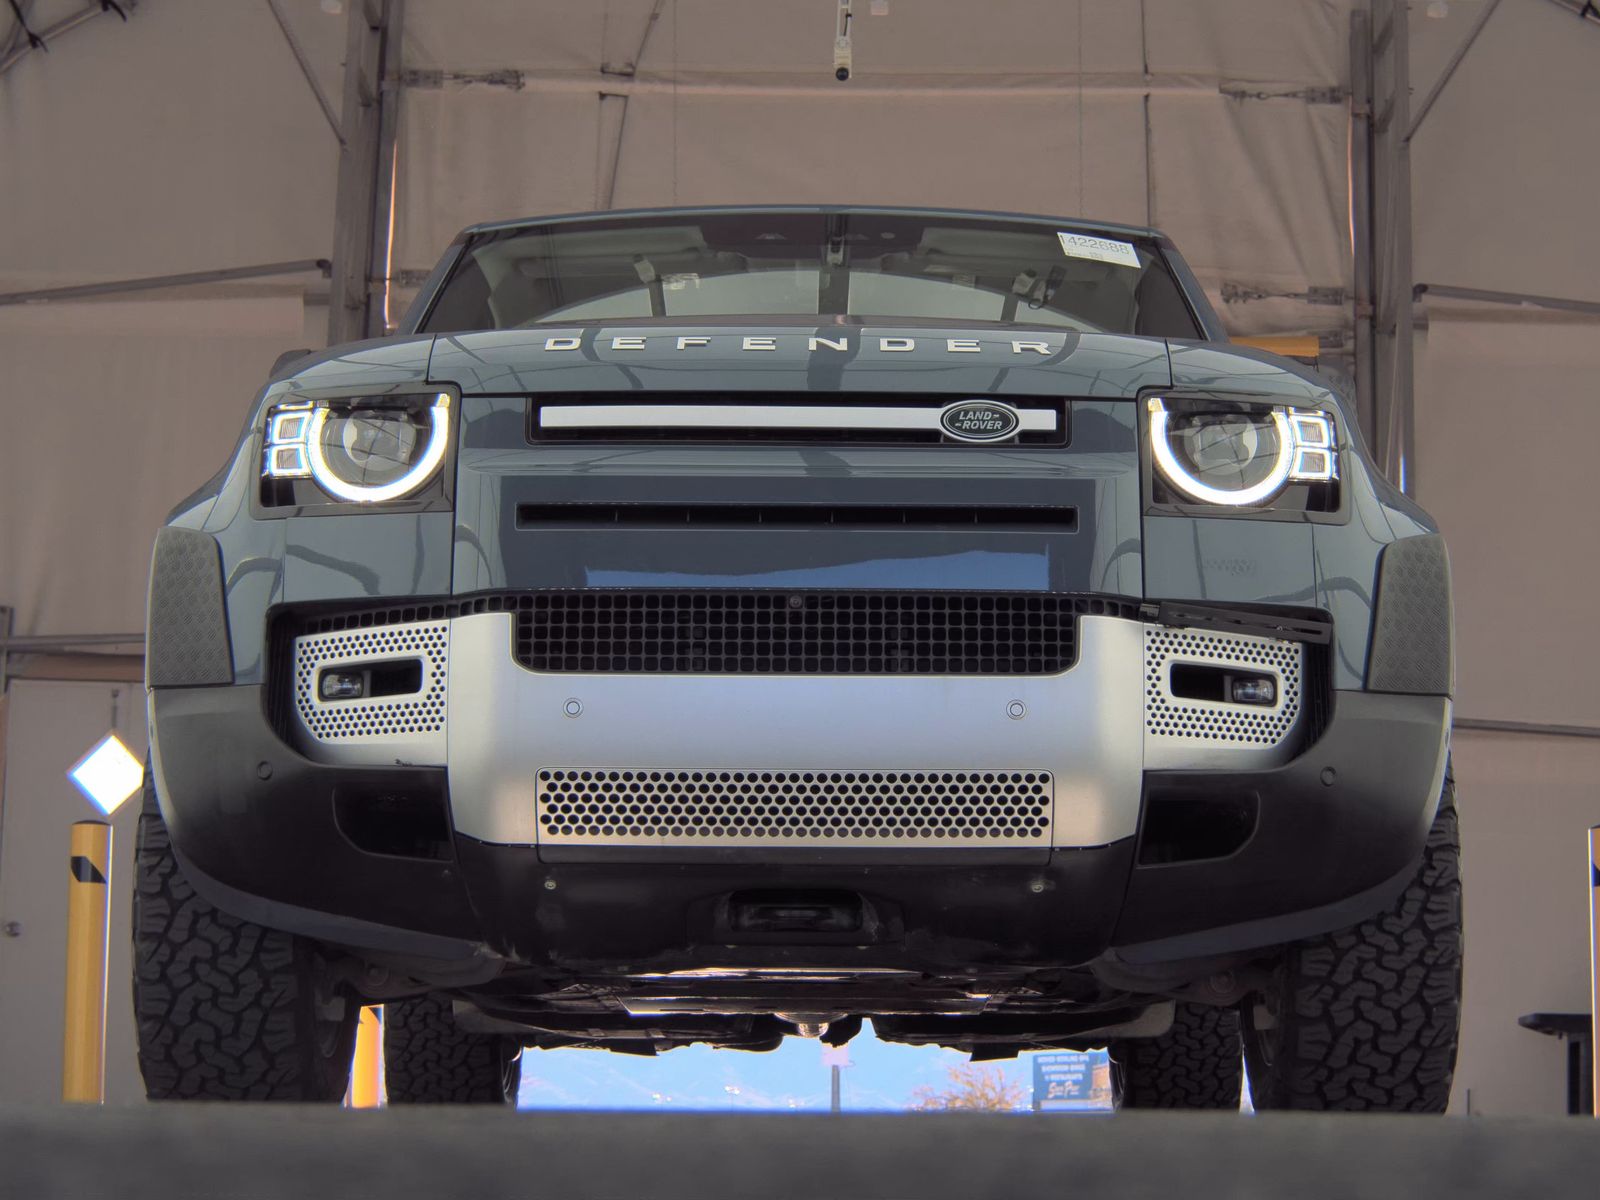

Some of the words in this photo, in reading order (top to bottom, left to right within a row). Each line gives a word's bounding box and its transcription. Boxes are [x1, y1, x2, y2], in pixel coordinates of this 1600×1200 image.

[544, 336, 1051, 355] DEFENDER
[959, 411, 993, 420] LAND
[961, 420, 1003, 430] ROVER
